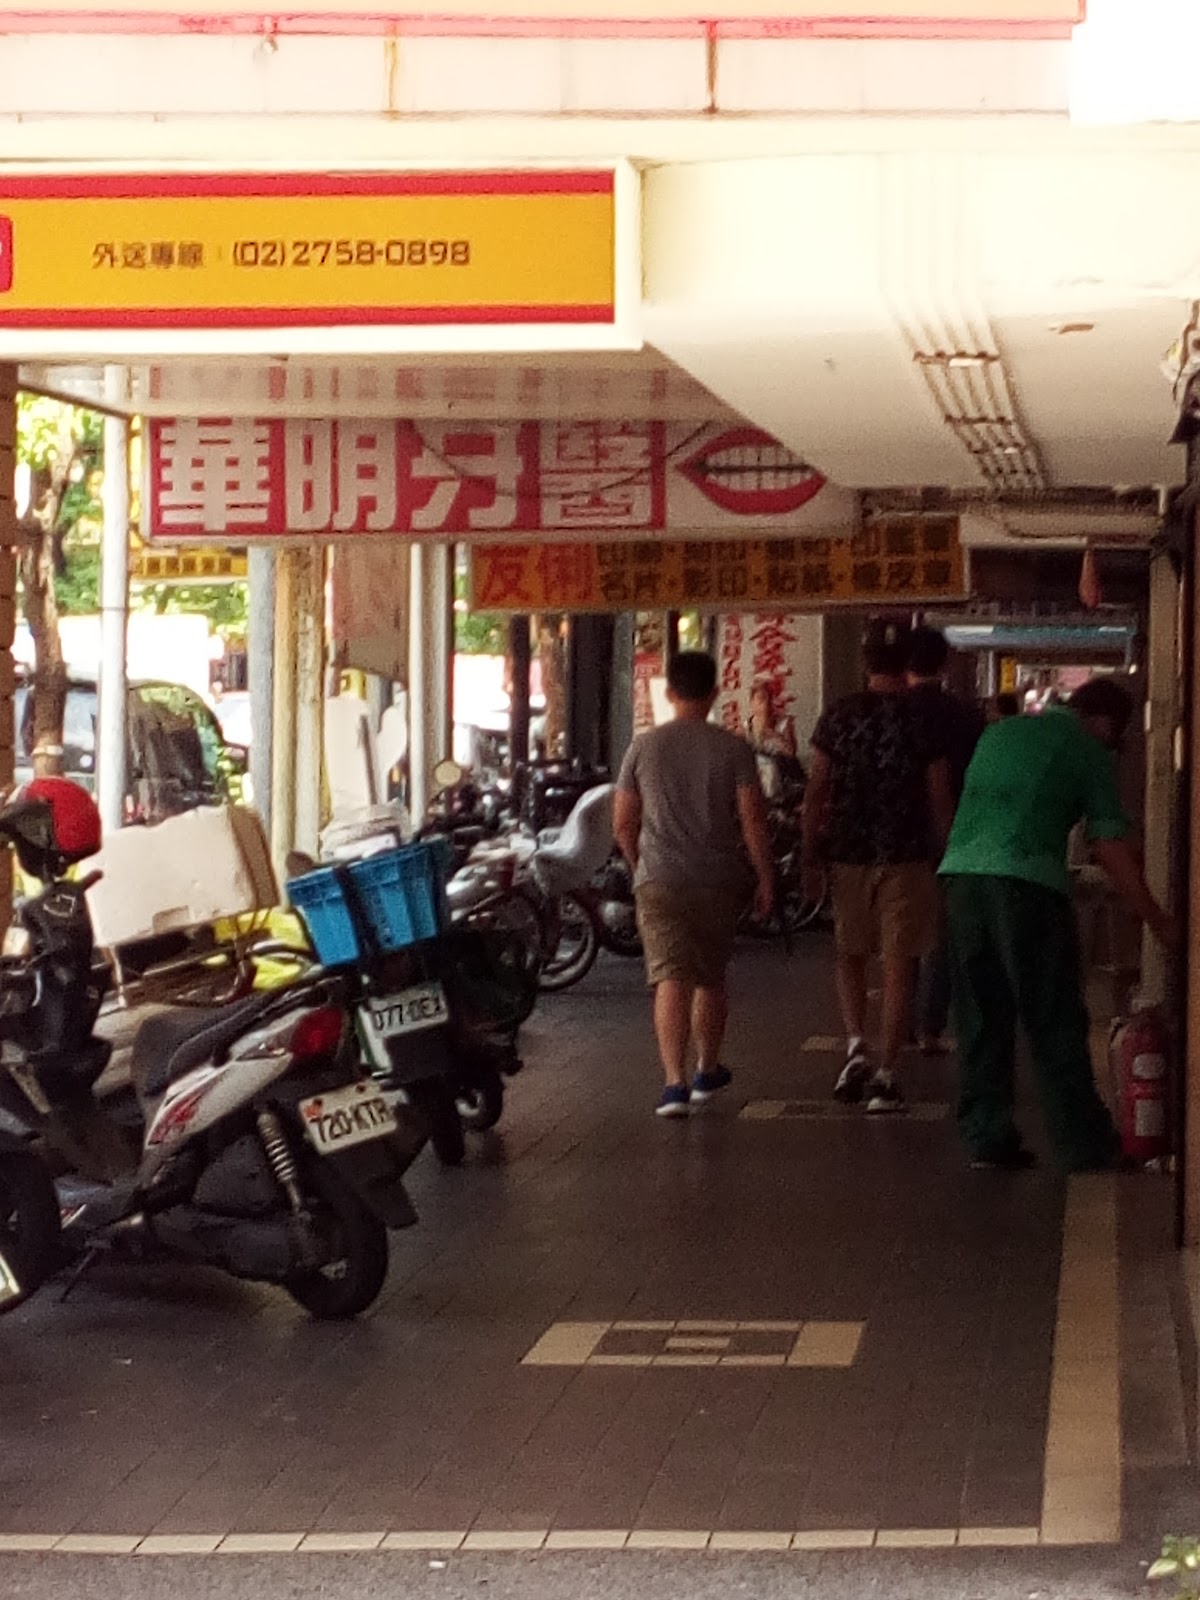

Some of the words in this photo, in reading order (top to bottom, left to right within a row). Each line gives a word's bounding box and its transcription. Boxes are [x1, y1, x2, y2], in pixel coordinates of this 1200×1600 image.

[233, 240, 470, 267] (02)2758-0898
[160, 417, 652, 531] 華明牙醫
